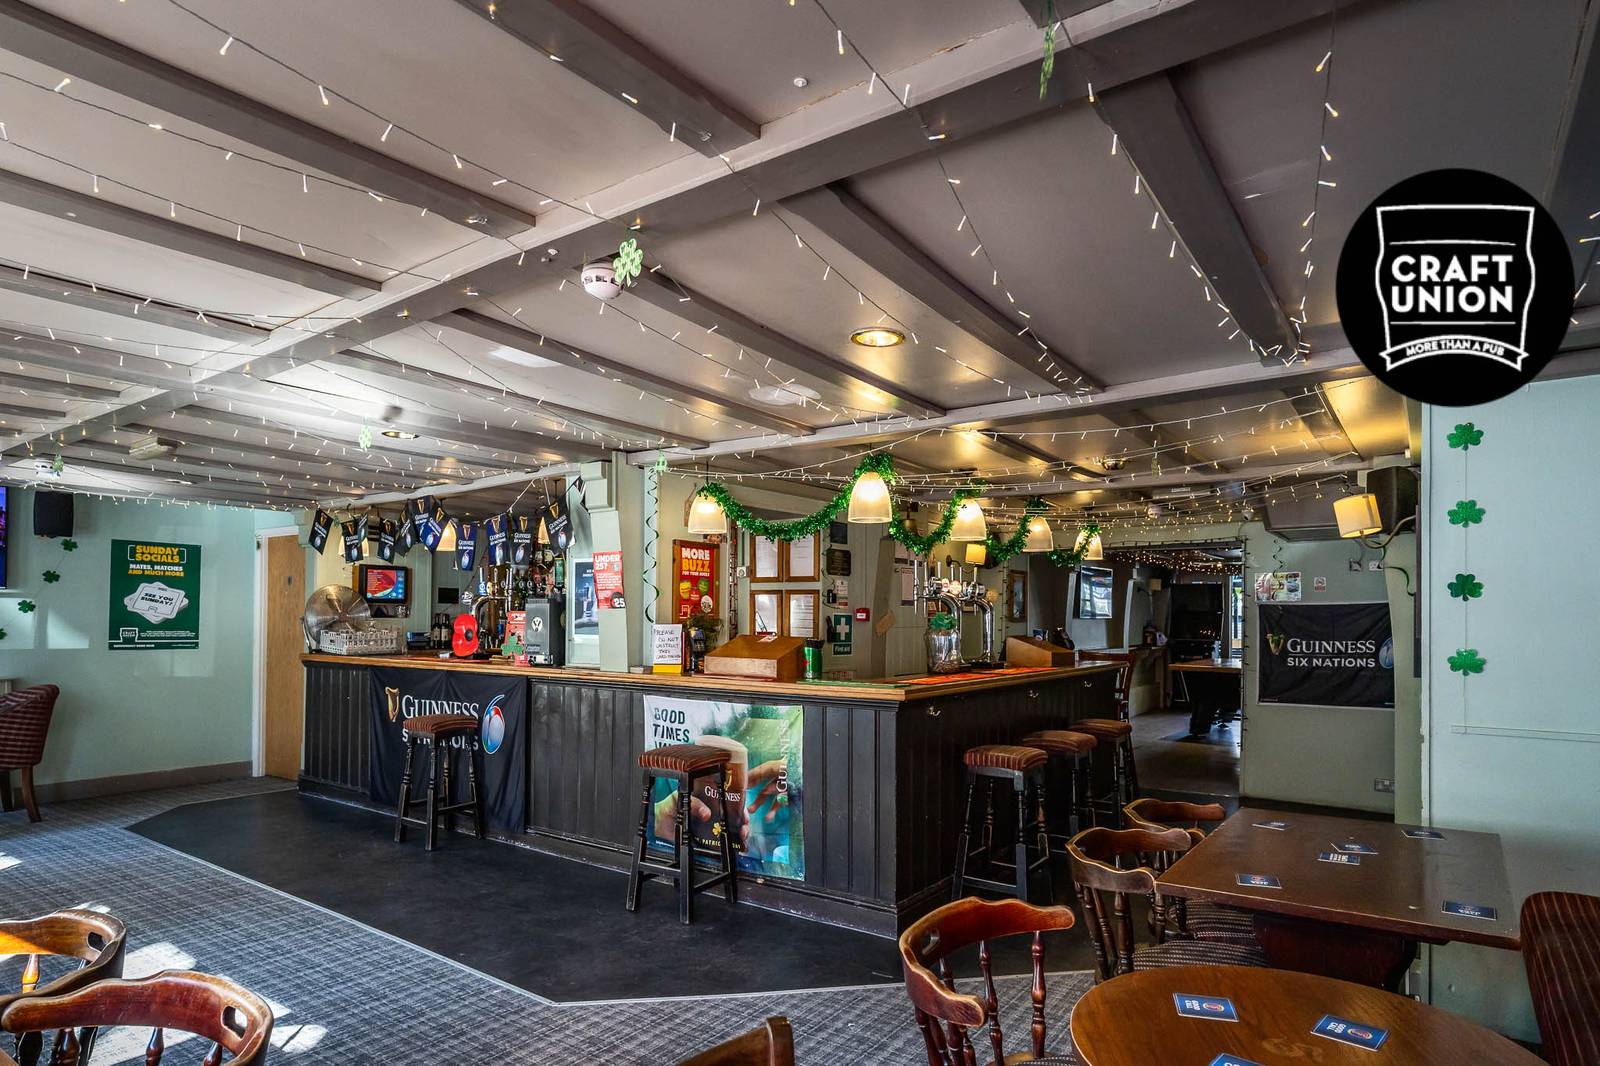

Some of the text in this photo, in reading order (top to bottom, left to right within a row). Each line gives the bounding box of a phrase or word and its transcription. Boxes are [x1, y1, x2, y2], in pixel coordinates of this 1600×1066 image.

[135, 545, 180, 555] SUNDAY
[681, 547, 710, 561] MORE
[135, 553, 180, 563] SOCIALS
[594, 554, 621, 563] UNDER
[154, 564, 183, 572] MATCHES
[681, 559, 710, 574] BUZZ
[613, 597, 625, 608] 25
[1287, 638, 1376, 654] GUINNESS
[1287, 657, 1376, 668] SIX NATIONS
[401, 694, 479, 719] GUINNESS
[653, 707, 685, 725] GOOD
[652, 723, 690, 743] TIMES
